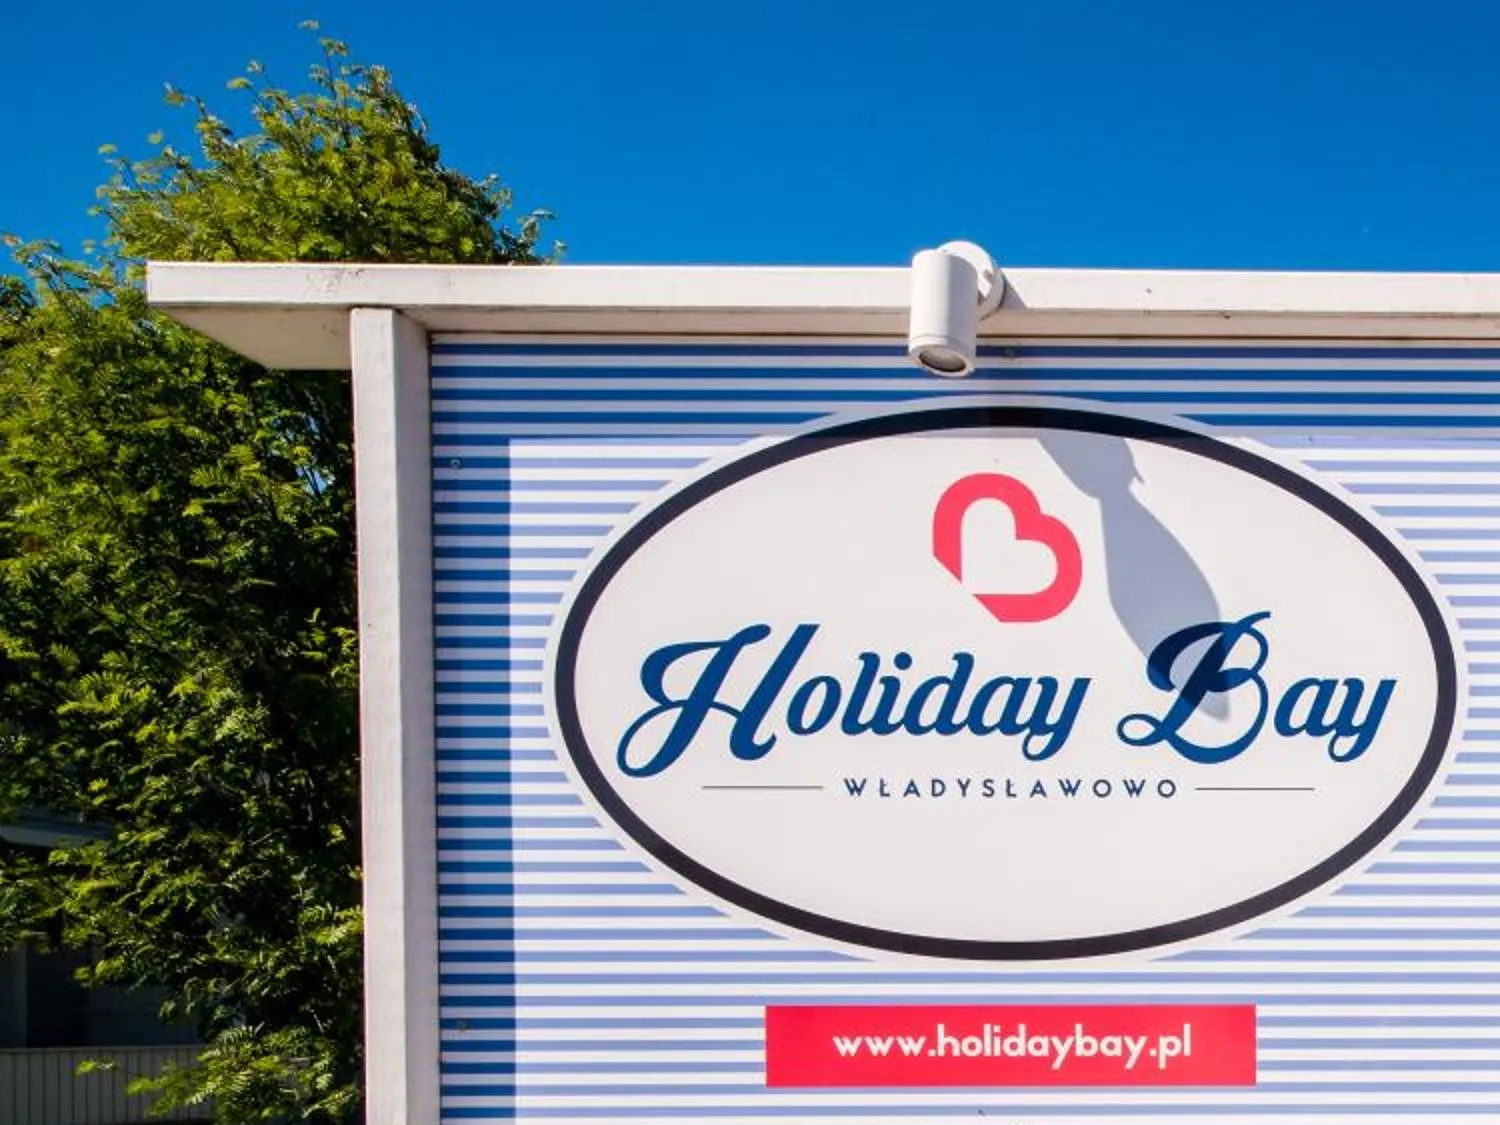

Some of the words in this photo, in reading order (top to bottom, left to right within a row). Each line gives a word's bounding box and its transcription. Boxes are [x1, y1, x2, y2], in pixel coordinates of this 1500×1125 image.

[616, 623, 1091, 778] Holiday
[1117, 611, 1397, 765] Bay
[843, 777, 1178, 800] WŁADYSŁAWOWO
[833, 1023, 1191, 1070] www.holidaybay.pl
